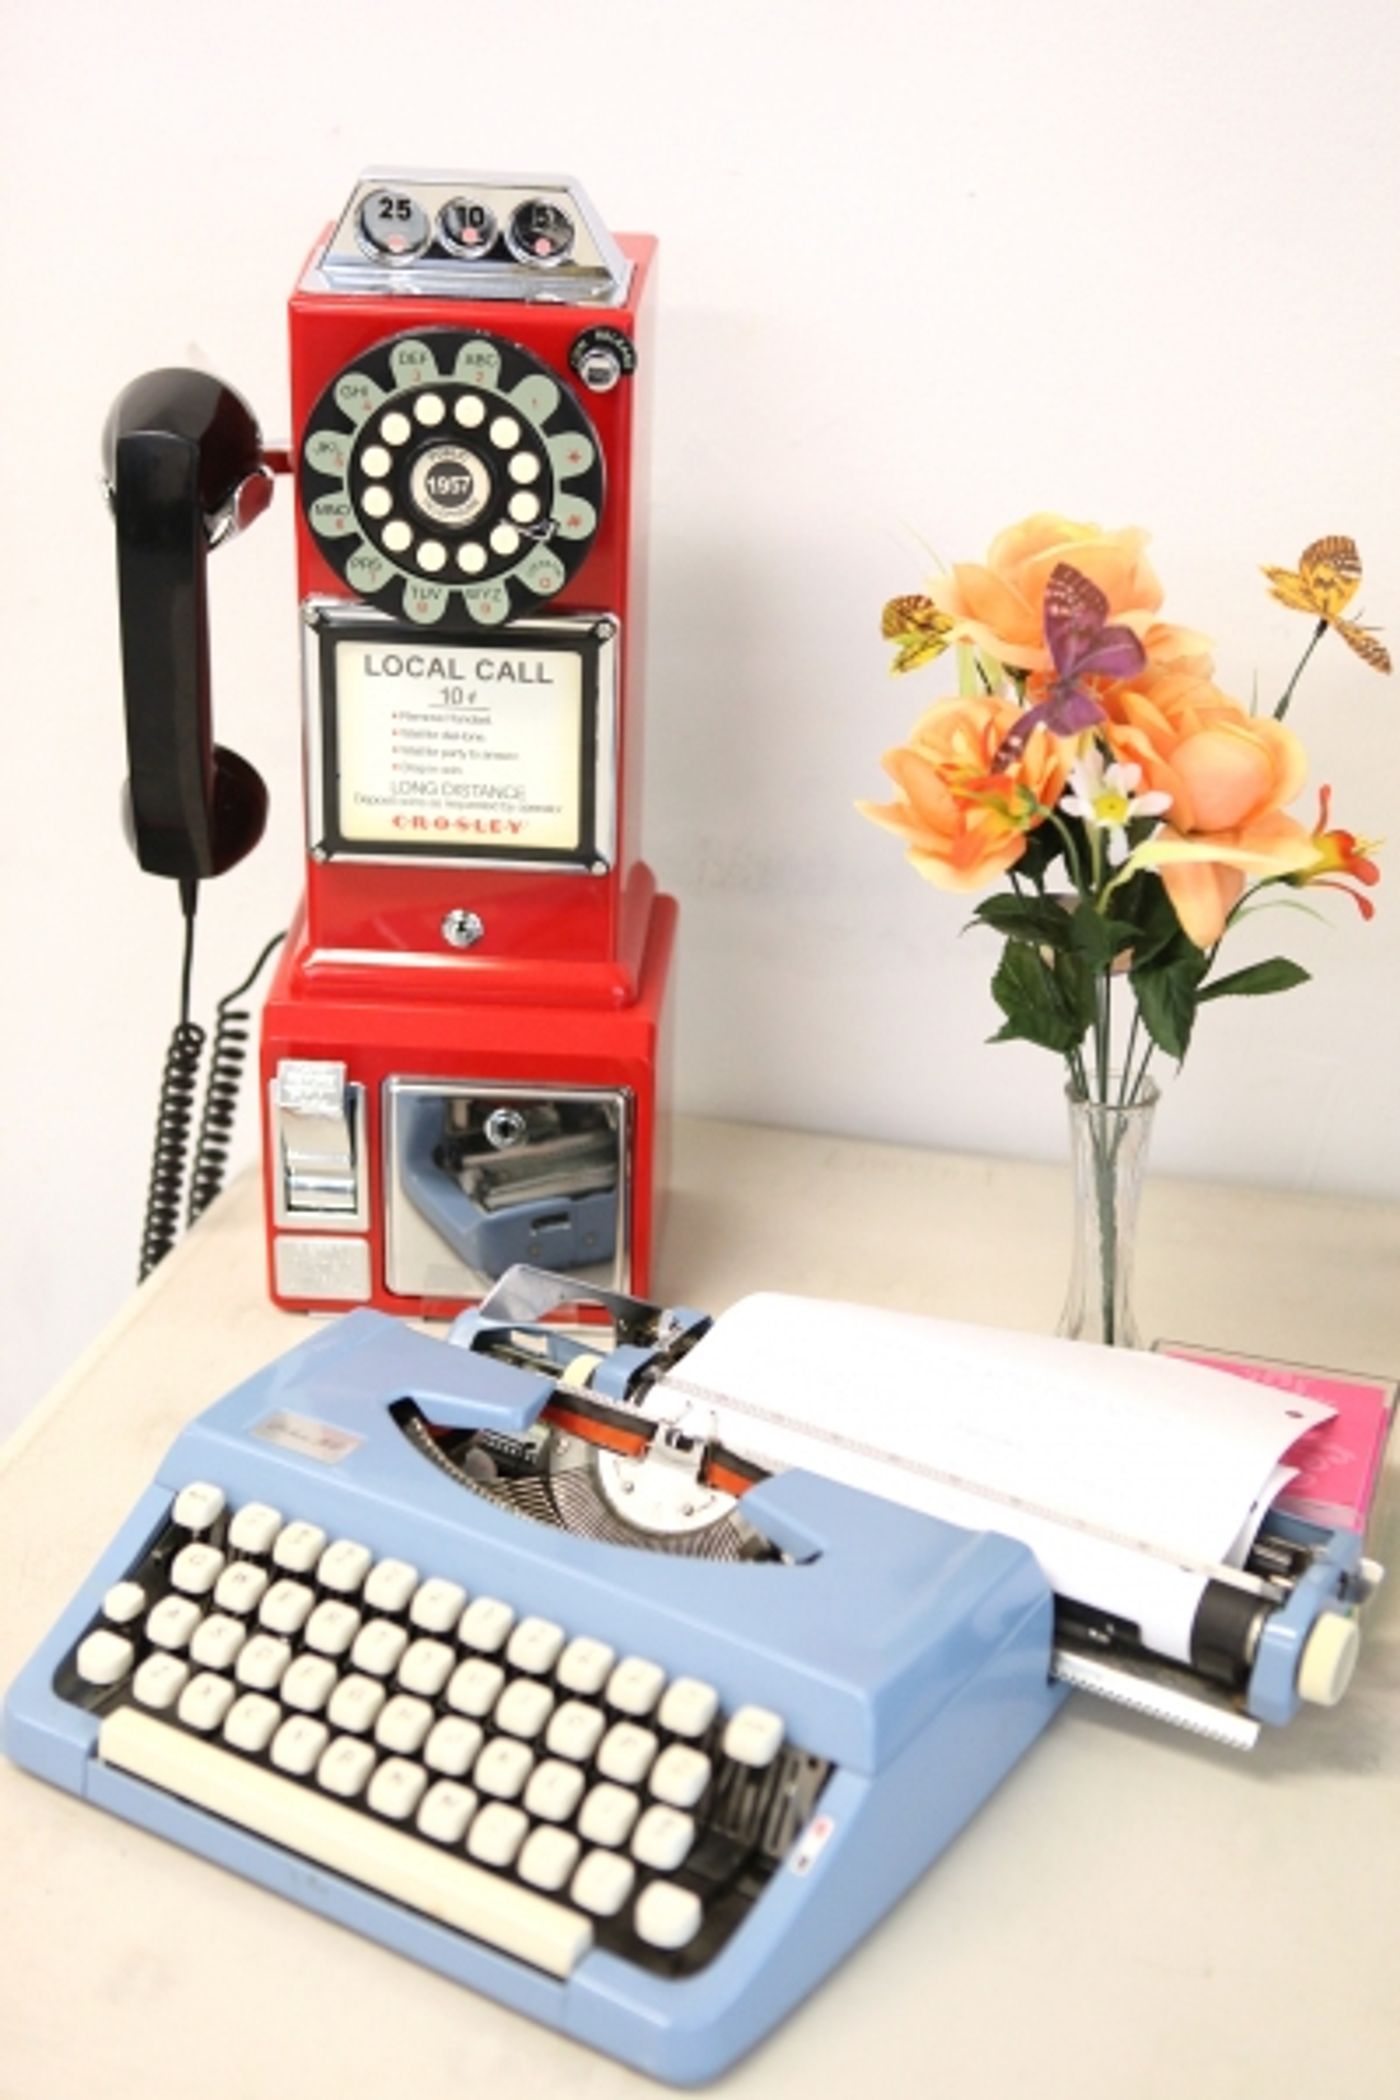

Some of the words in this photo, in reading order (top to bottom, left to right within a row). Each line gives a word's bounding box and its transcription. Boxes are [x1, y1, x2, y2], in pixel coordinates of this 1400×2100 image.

[379, 198, 412, 221] 25
[455, 204, 485, 230] 10
[398, 350, 426, 366] DEF
[427, 475, 471, 496] 1957
[411, 586, 442, 600] TUV
[363, 654, 467, 681] LOCAL
[475, 658, 555, 685] CALL
[440, 686, 464, 706] 10
[389, 780, 439, 796] LONG
[441, 781, 526, 801] DISTANCE
[391, 814, 523, 834] CROSLEY
